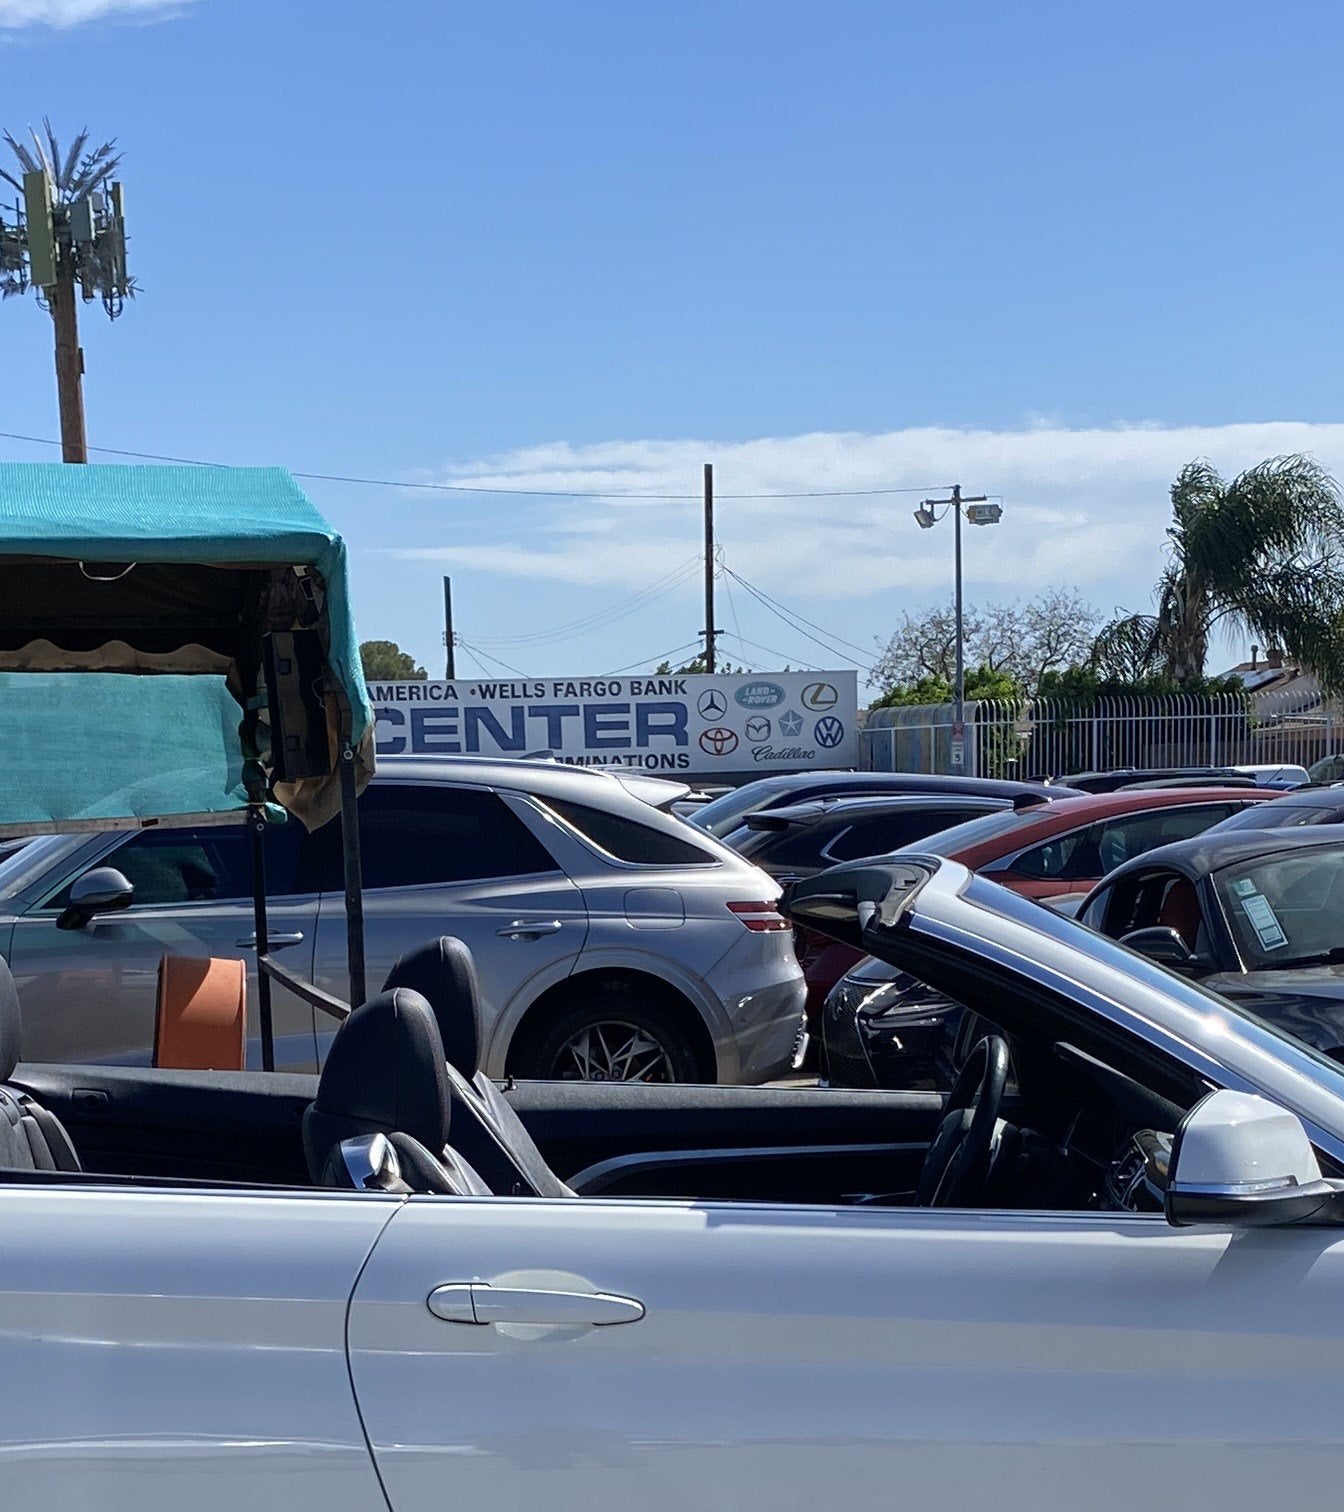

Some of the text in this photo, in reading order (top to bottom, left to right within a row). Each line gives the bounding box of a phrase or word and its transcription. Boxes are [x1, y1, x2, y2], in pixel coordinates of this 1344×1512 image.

[477, 683, 546, 700] WELLS
[553, 681, 622, 698] FARGO
[630, 680, 688, 696] BANK
[374, 702, 689, 755] CENTER
[555, 753, 690, 770] MINATIONS
[751, 745, 816, 762] Cadillac
